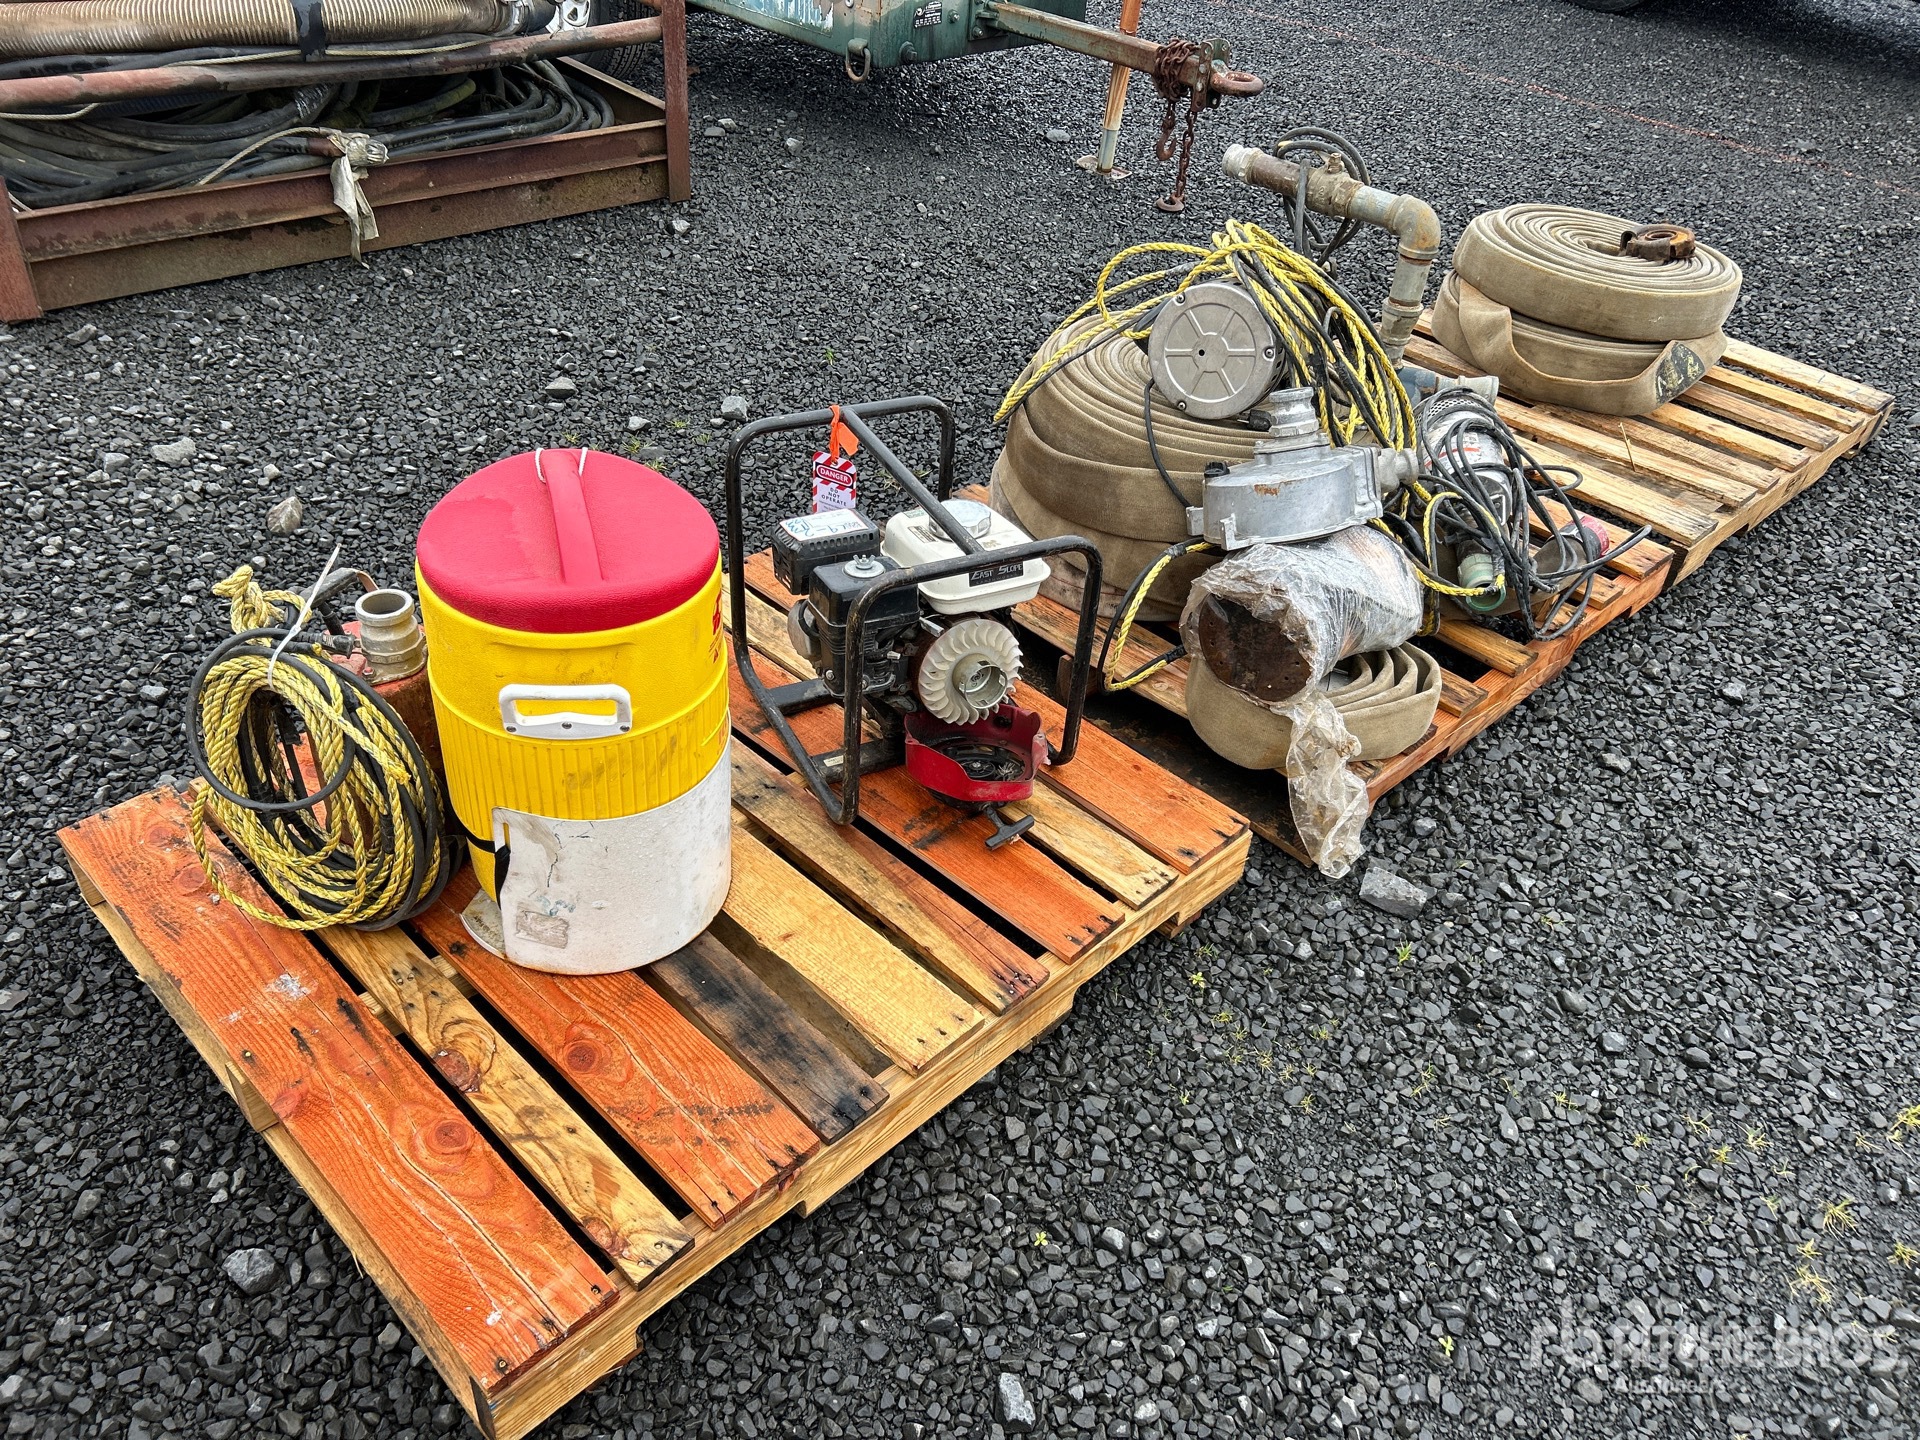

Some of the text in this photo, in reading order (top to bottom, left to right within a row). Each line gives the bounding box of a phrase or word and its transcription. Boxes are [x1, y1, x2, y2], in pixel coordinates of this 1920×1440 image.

[820, 467, 849, 483] DANGER
[821, 494, 847, 506] OPERATE
[971, 563, 1023, 581] EAST SLOPE
